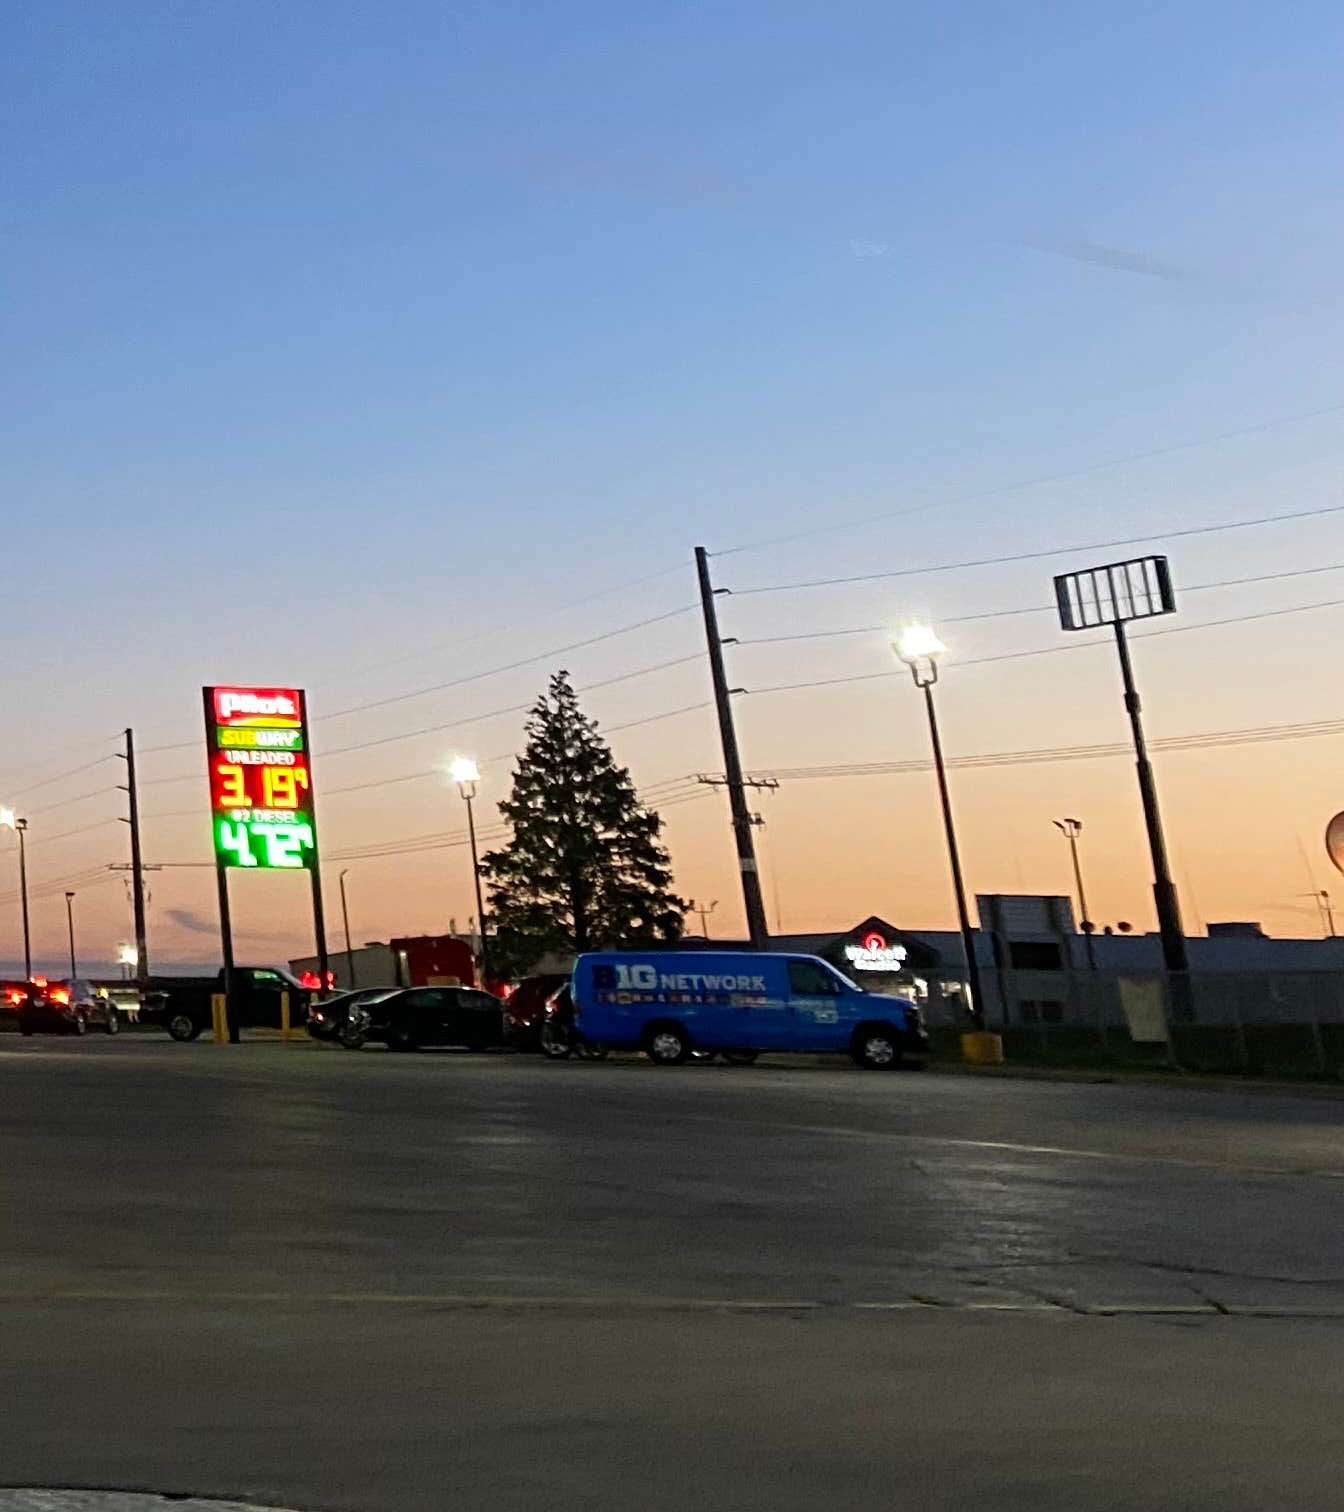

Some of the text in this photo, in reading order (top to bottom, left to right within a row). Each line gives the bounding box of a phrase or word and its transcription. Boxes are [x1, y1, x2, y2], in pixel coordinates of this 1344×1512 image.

[221, 729, 300, 747] SUBWAY
[225, 750, 296, 765] UNLEADED
[659, 974, 766, 992] NETWORK
